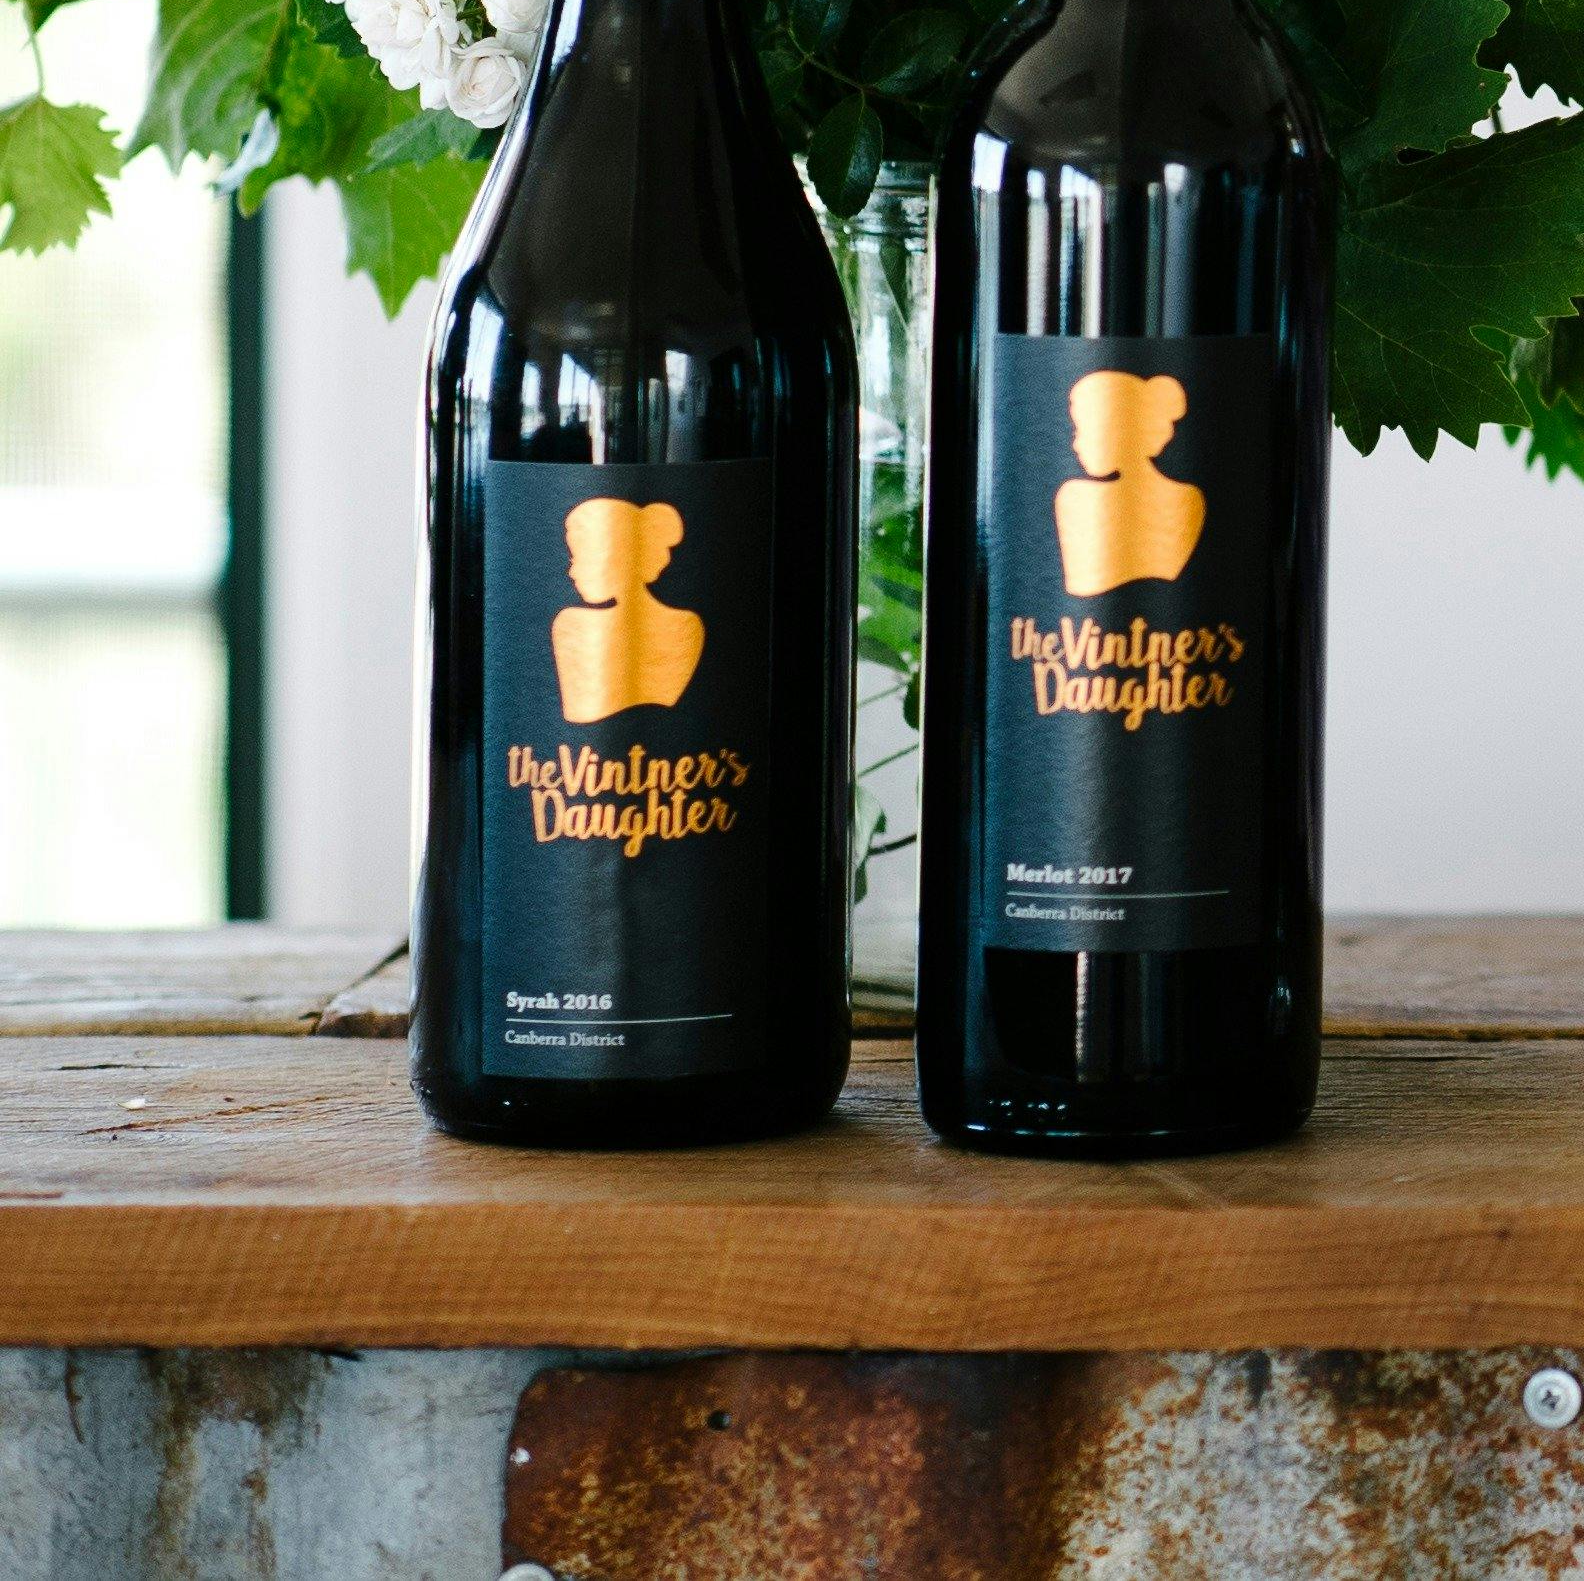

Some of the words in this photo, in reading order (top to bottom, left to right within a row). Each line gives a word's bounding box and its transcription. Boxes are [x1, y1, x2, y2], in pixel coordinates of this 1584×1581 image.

[1060, 616, 1245, 670] Vintner's
[1033, 661, 1233, 731] Daughter
[558, 744, 749, 797] Vintner's
[531, 788, 737, 858] Daughter
[1006, 863, 1074, 885] Merlot
[1078, 865, 1133, 885] 2017
[1004, 901, 1067, 920] Canberra
[1069, 904, 1125, 921] District
[505, 991, 560, 1013] Syrah
[562, 993, 613, 1011] 2016
[504, 1029, 567, 1047] Canberra
[569, 1031, 626, 1047] District
